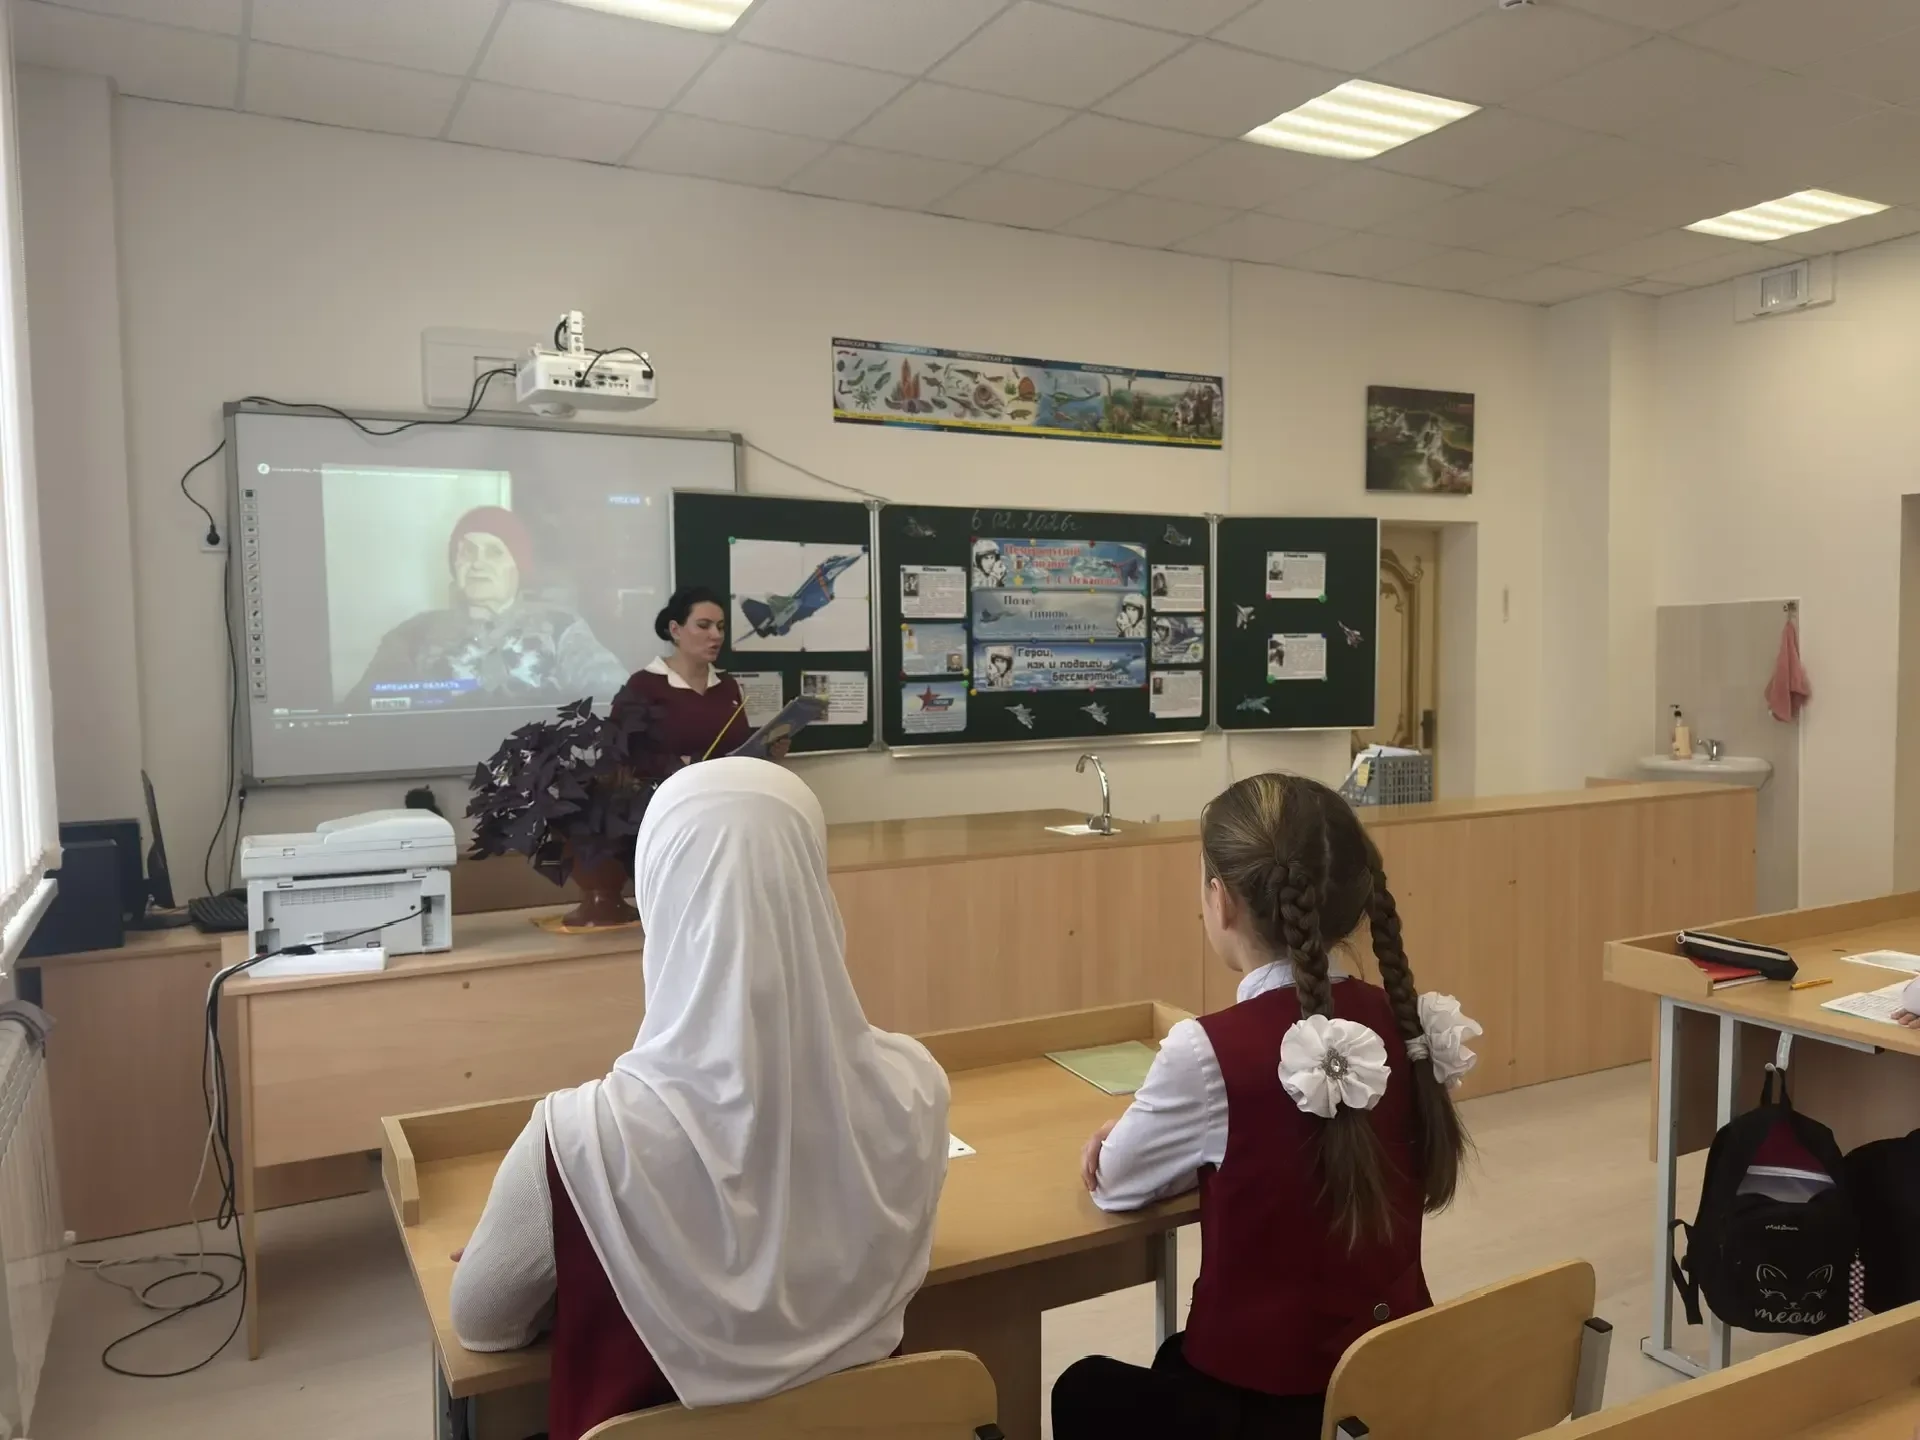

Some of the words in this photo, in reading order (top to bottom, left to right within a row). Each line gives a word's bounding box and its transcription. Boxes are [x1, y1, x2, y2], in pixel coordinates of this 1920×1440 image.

[971, 510, 983, 531] 6
[1027, 661, 1045, 669] как
[1049, 661, 1056, 669] и
[1754, 1308, 1827, 1325] meow
